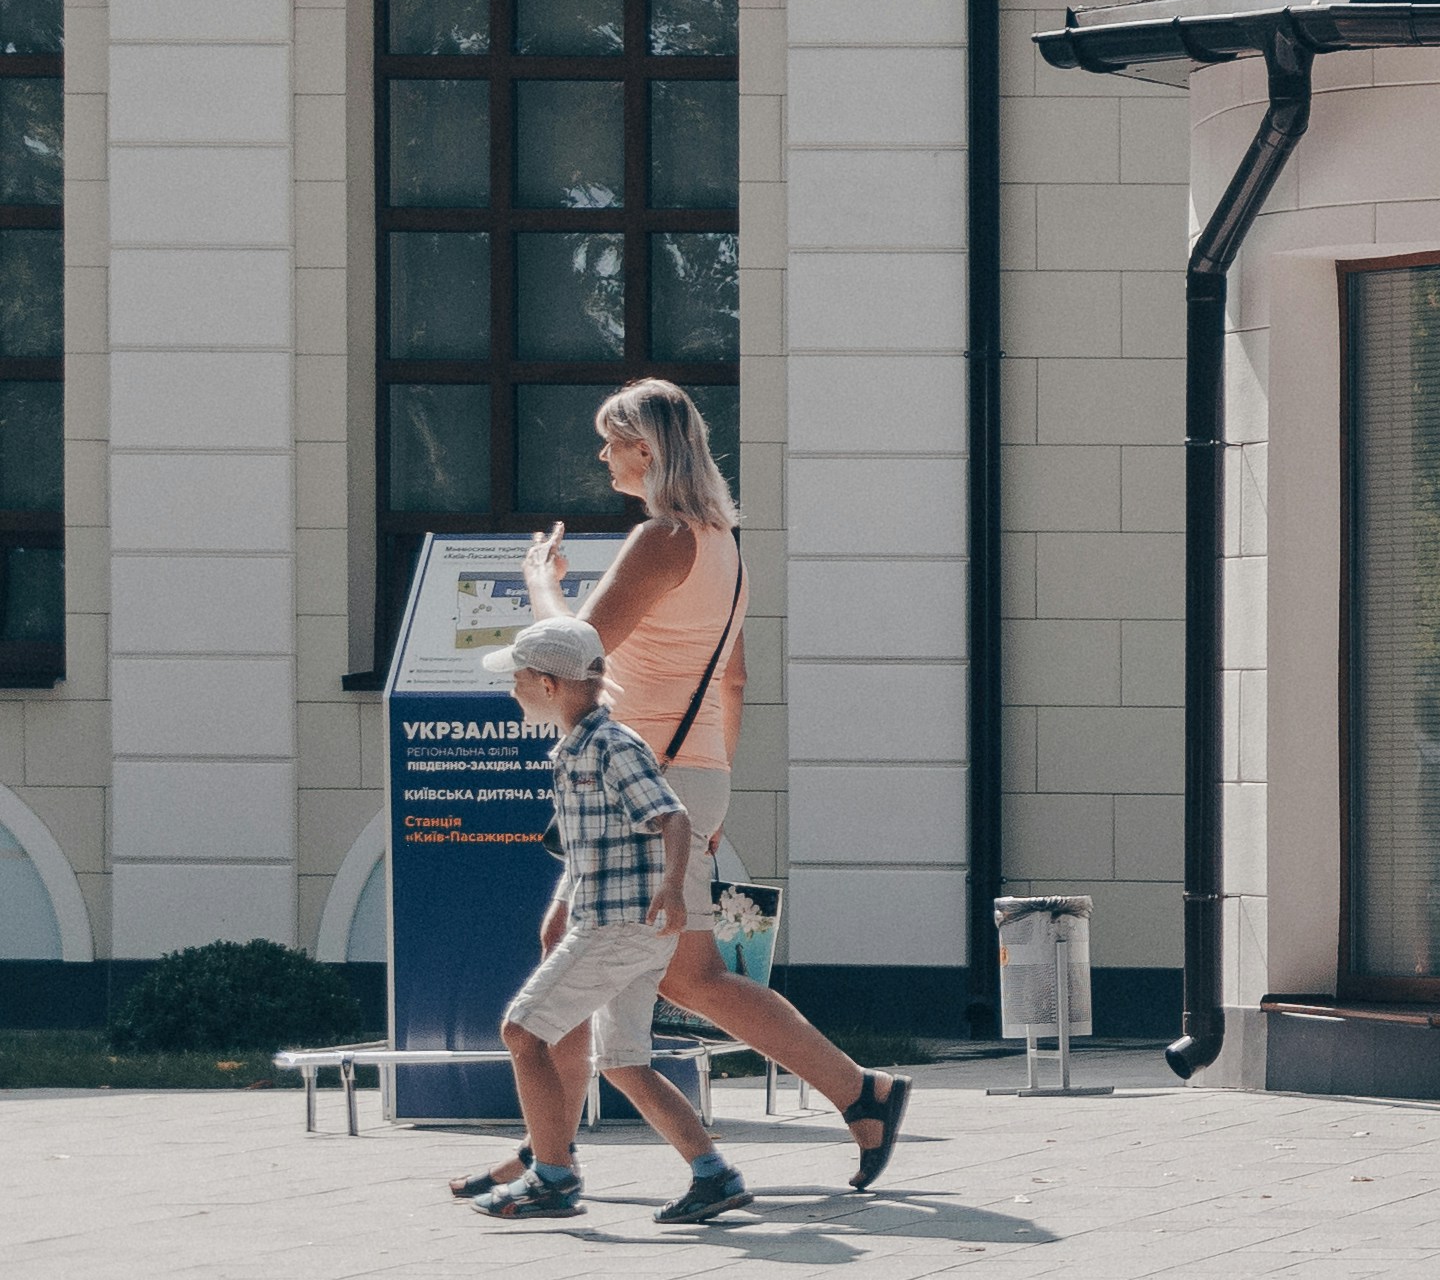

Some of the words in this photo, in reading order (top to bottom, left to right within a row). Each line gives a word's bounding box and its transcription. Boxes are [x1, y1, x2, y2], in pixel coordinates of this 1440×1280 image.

[407, 746, 486, 757] РЕГІОНАЛЬНА
[488, 746, 519, 757] ФІЛІЯ
[407, 760, 522, 772] ПІВДЕННО-ЗАХІДНА
[404, 787, 474, 801] КИЇВСЬКА
[477, 788, 534, 802] ДИТЯЧА
[536, 788, 556, 800] ЗА
[404, 815, 463, 829] Станція
